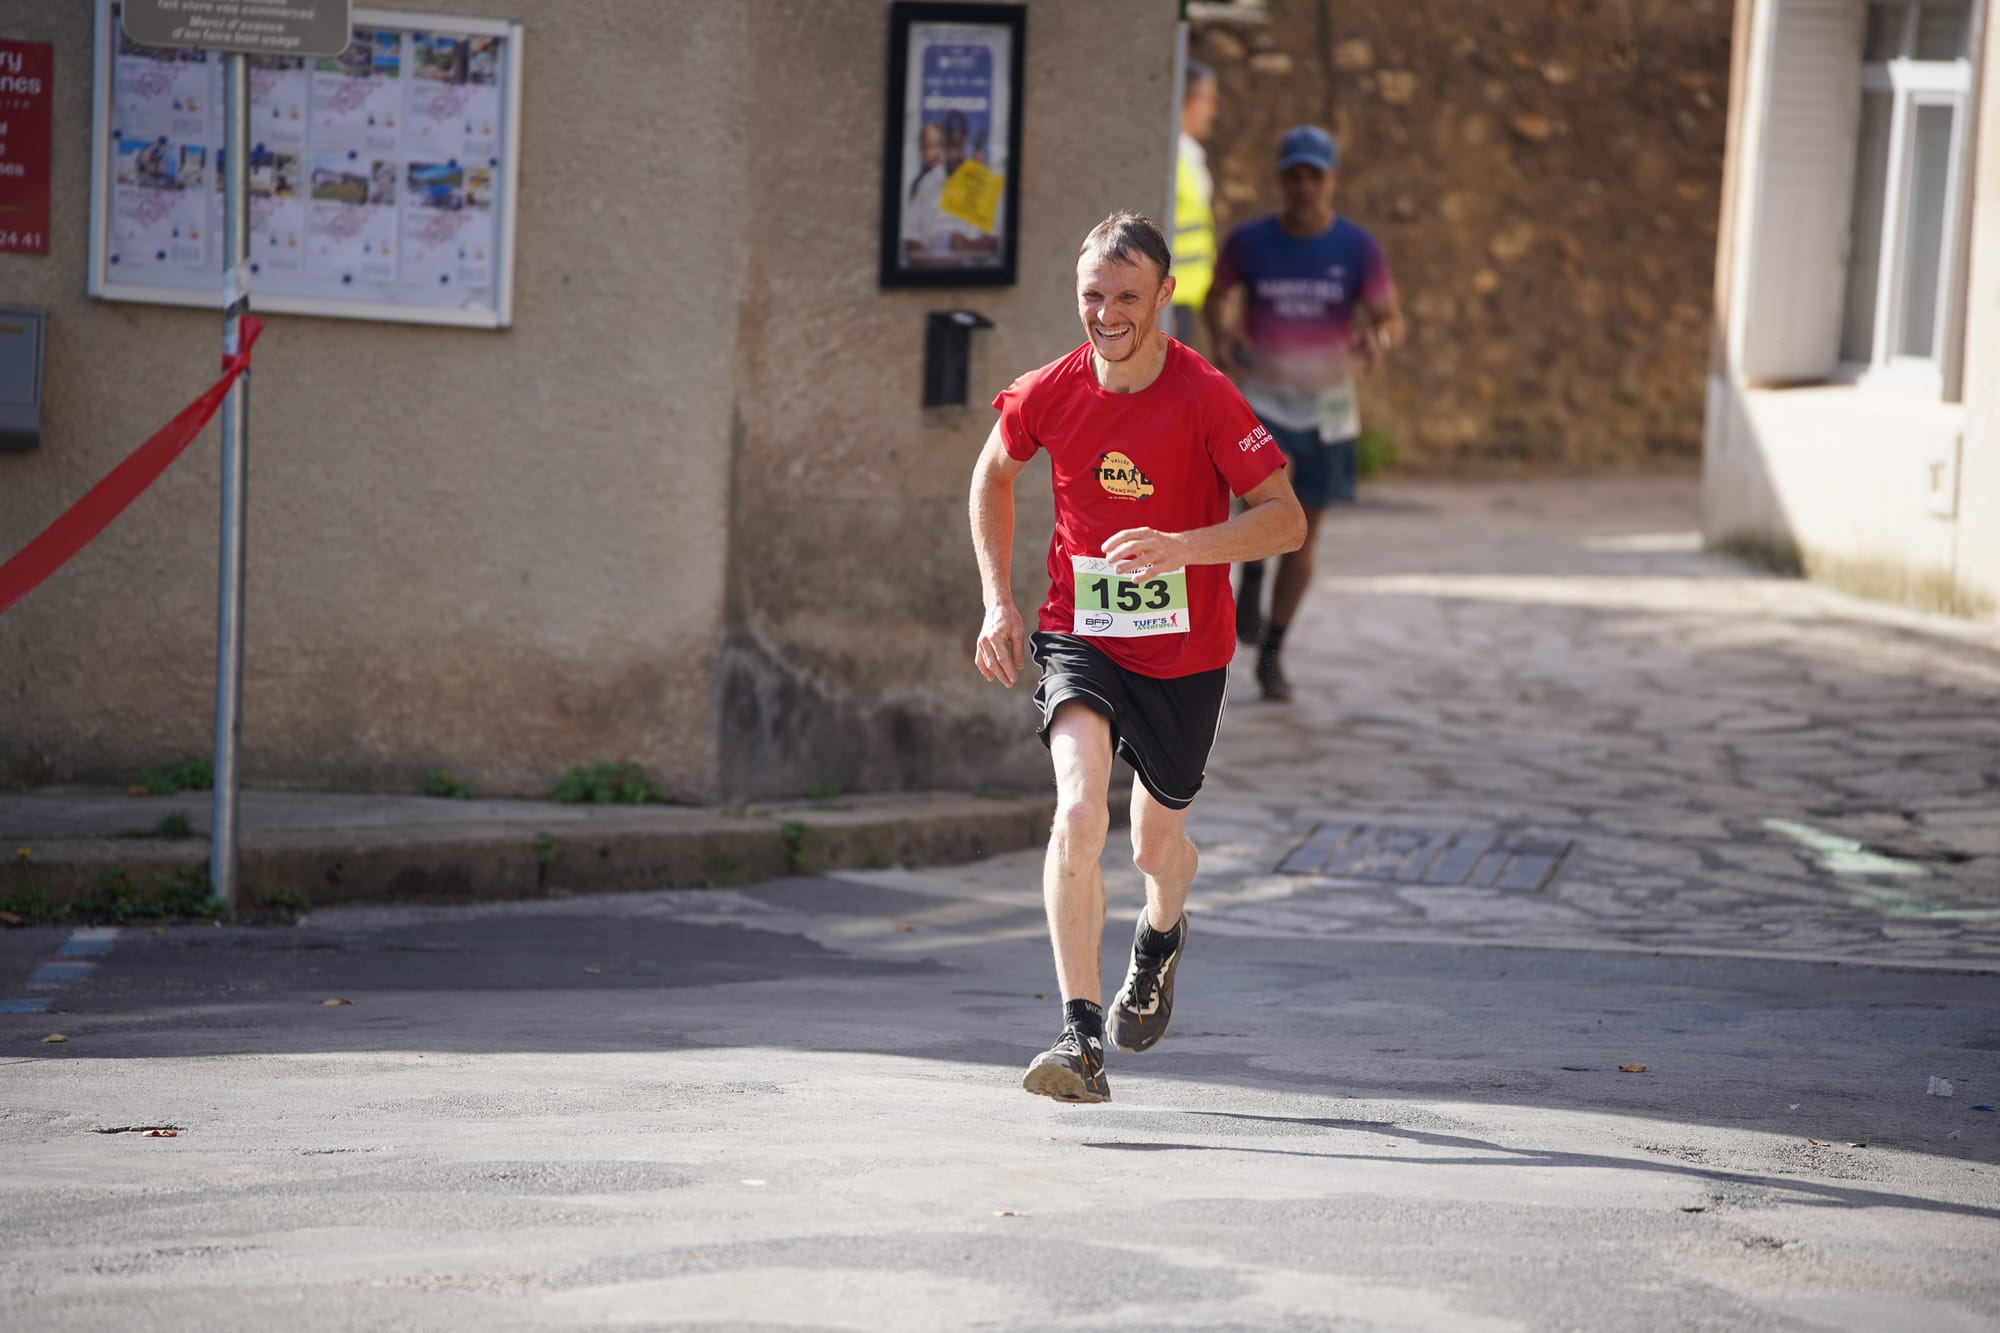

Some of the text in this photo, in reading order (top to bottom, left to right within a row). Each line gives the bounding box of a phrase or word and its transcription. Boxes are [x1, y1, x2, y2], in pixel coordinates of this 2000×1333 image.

[189, 15, 226, 29] Merci
[233, 31, 260, 44] bon
[261, 35, 302, 48] usage
[22, 230, 42, 249] 41
[1252, 424, 1267, 440] DU
[1091, 578, 1171, 612] 153
[1085, 617, 1168, 627] BFP TUFF'S
